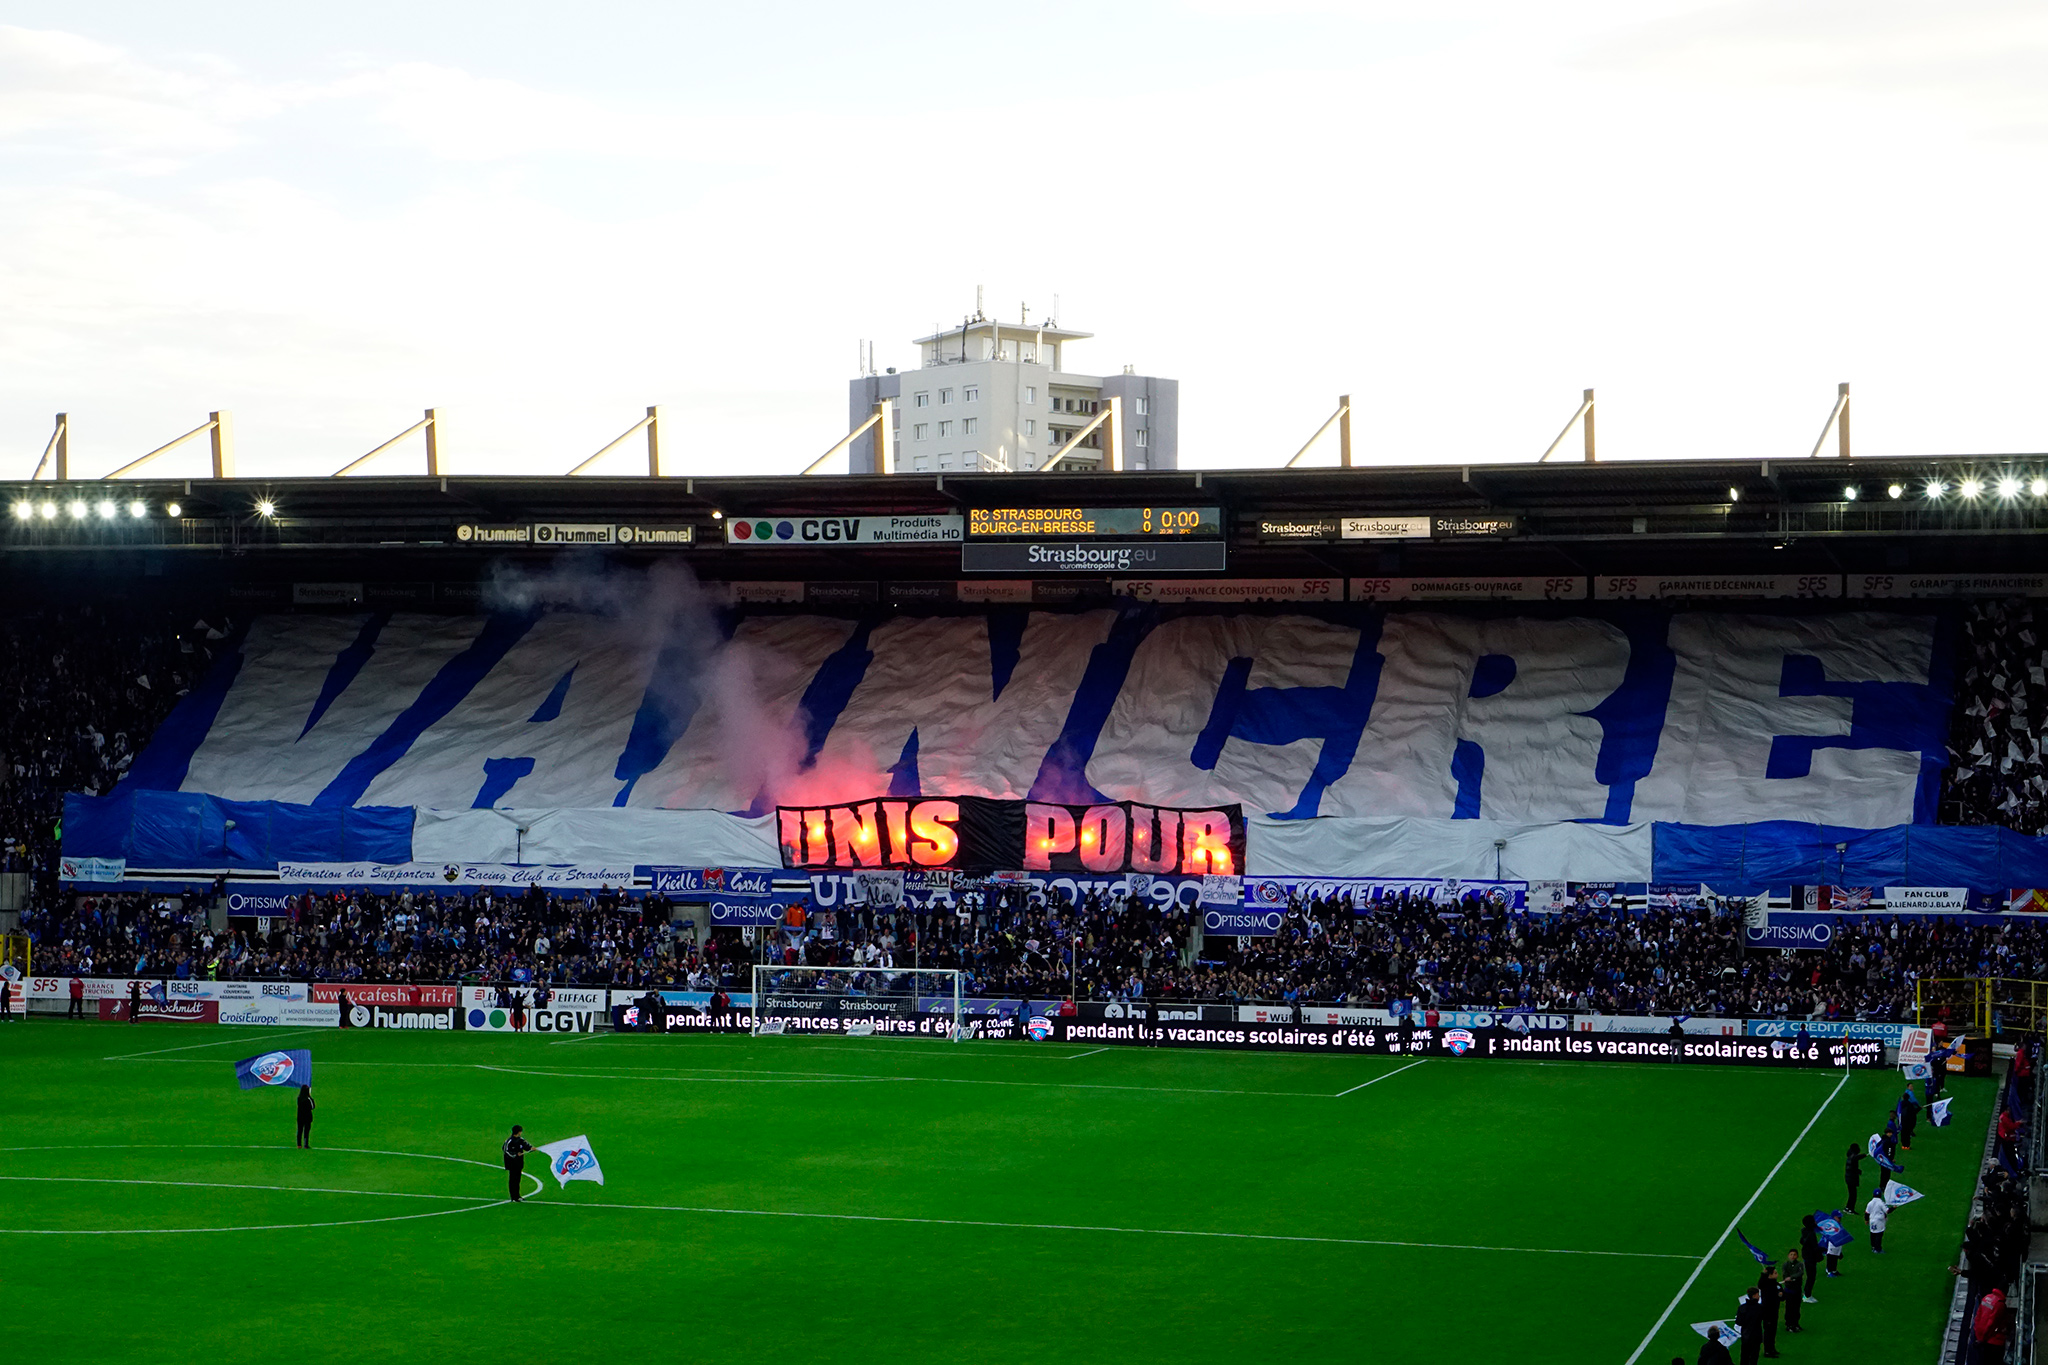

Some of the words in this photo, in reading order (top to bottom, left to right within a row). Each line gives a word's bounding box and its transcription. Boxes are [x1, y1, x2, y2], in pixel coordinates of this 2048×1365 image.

[971, 509, 989, 521] RC
[993, 509, 1082, 521] STRASBOURG
[1143, 507, 1152, 519] 0
[1161, 510, 1200, 528] 0:00
[891, 518, 941, 528] Produits
[970, 521, 1096, 534] BOURG-EN-BRESSE
[1143, 520, 1152, 533] 0
[474, 525, 531, 541] hummel
[555, 526, 610, 542] hummel
[634, 526, 692, 542] hummel
[801, 519, 860, 541] CGV
[873, 529, 938, 541] Multimédia
[942, 529, 960, 539] HD
[1060, 561, 1115, 571] eurométropole
[1126, 582, 1152, 595] SFS
[1159, 586, 1217, 596] ASSURANCE
[1219, 586, 1295, 595] CONSTRUCTION
[1302, 580, 1330, 594] SFS
[1363, 580, 1391, 593] SFS
[1545, 579, 1573, 592] SFS
[1609, 578, 1637, 592] SFS
[1659, 581, 1711, 590] GARANTIE
[1714, 579, 1775, 590] DÉCENNALE
[1798, 577, 1827, 591] SFS
[1863, 576, 1893, 590] SFS
[779, 800, 960, 868] UNIS
[1023, 802, 1233, 876] POUR
[280, 865, 342, 880] Fédération
[346, 867, 364, 879] des
[370, 866, 436, 884] Supporters
[465, 867, 506, 884] Racing
[512, 866, 543, 883] Club
[547, 871, 561, 882] de
[565, 867, 632, 884] Strasbourg
[656, 871, 698, 891] Vieille
[730, 873, 767, 892] Garde
[1296, 881, 1336, 904] KOP
[711, 901, 784, 920] OPTISSIMO
[259, 917, 269, 927] 17
[1204, 910, 1283, 931] OPTISSIMO
[743, 926, 754, 936] 18
[32, 979, 58, 992] SFS
[171, 982, 199, 993] BEYER
[262, 984, 290, 995] BEYER
[558, 993, 598, 1003] EIFFAGE
[219, 1012, 278, 1025] CroisiEurope
[374, 1005, 454, 1030] hummel
[535, 1011, 593, 1032] CGV
[1341, 1015, 1382, 1026] WÜRTH
[987, 1028, 1005, 1039] PRO
[1066, 1022, 1135, 1041] pendant
[1167, 1028, 1245, 1043] vacances
[1249, 1028, 1327, 1045] scolaires
[1331, 1029, 1376, 1047] d'été
[1842, 1022, 1902, 1034] AGRICOL
[1566, 1036, 1593, 1053] les
[1684, 1041, 1768, 1059] scolaires
[1829, 1045, 1844, 1055] VIS
[1848, 1043, 1881, 1054] COMME
[1833, 1056, 1846, 1066] UN
[1849, 1055, 1870, 1065] PRO
